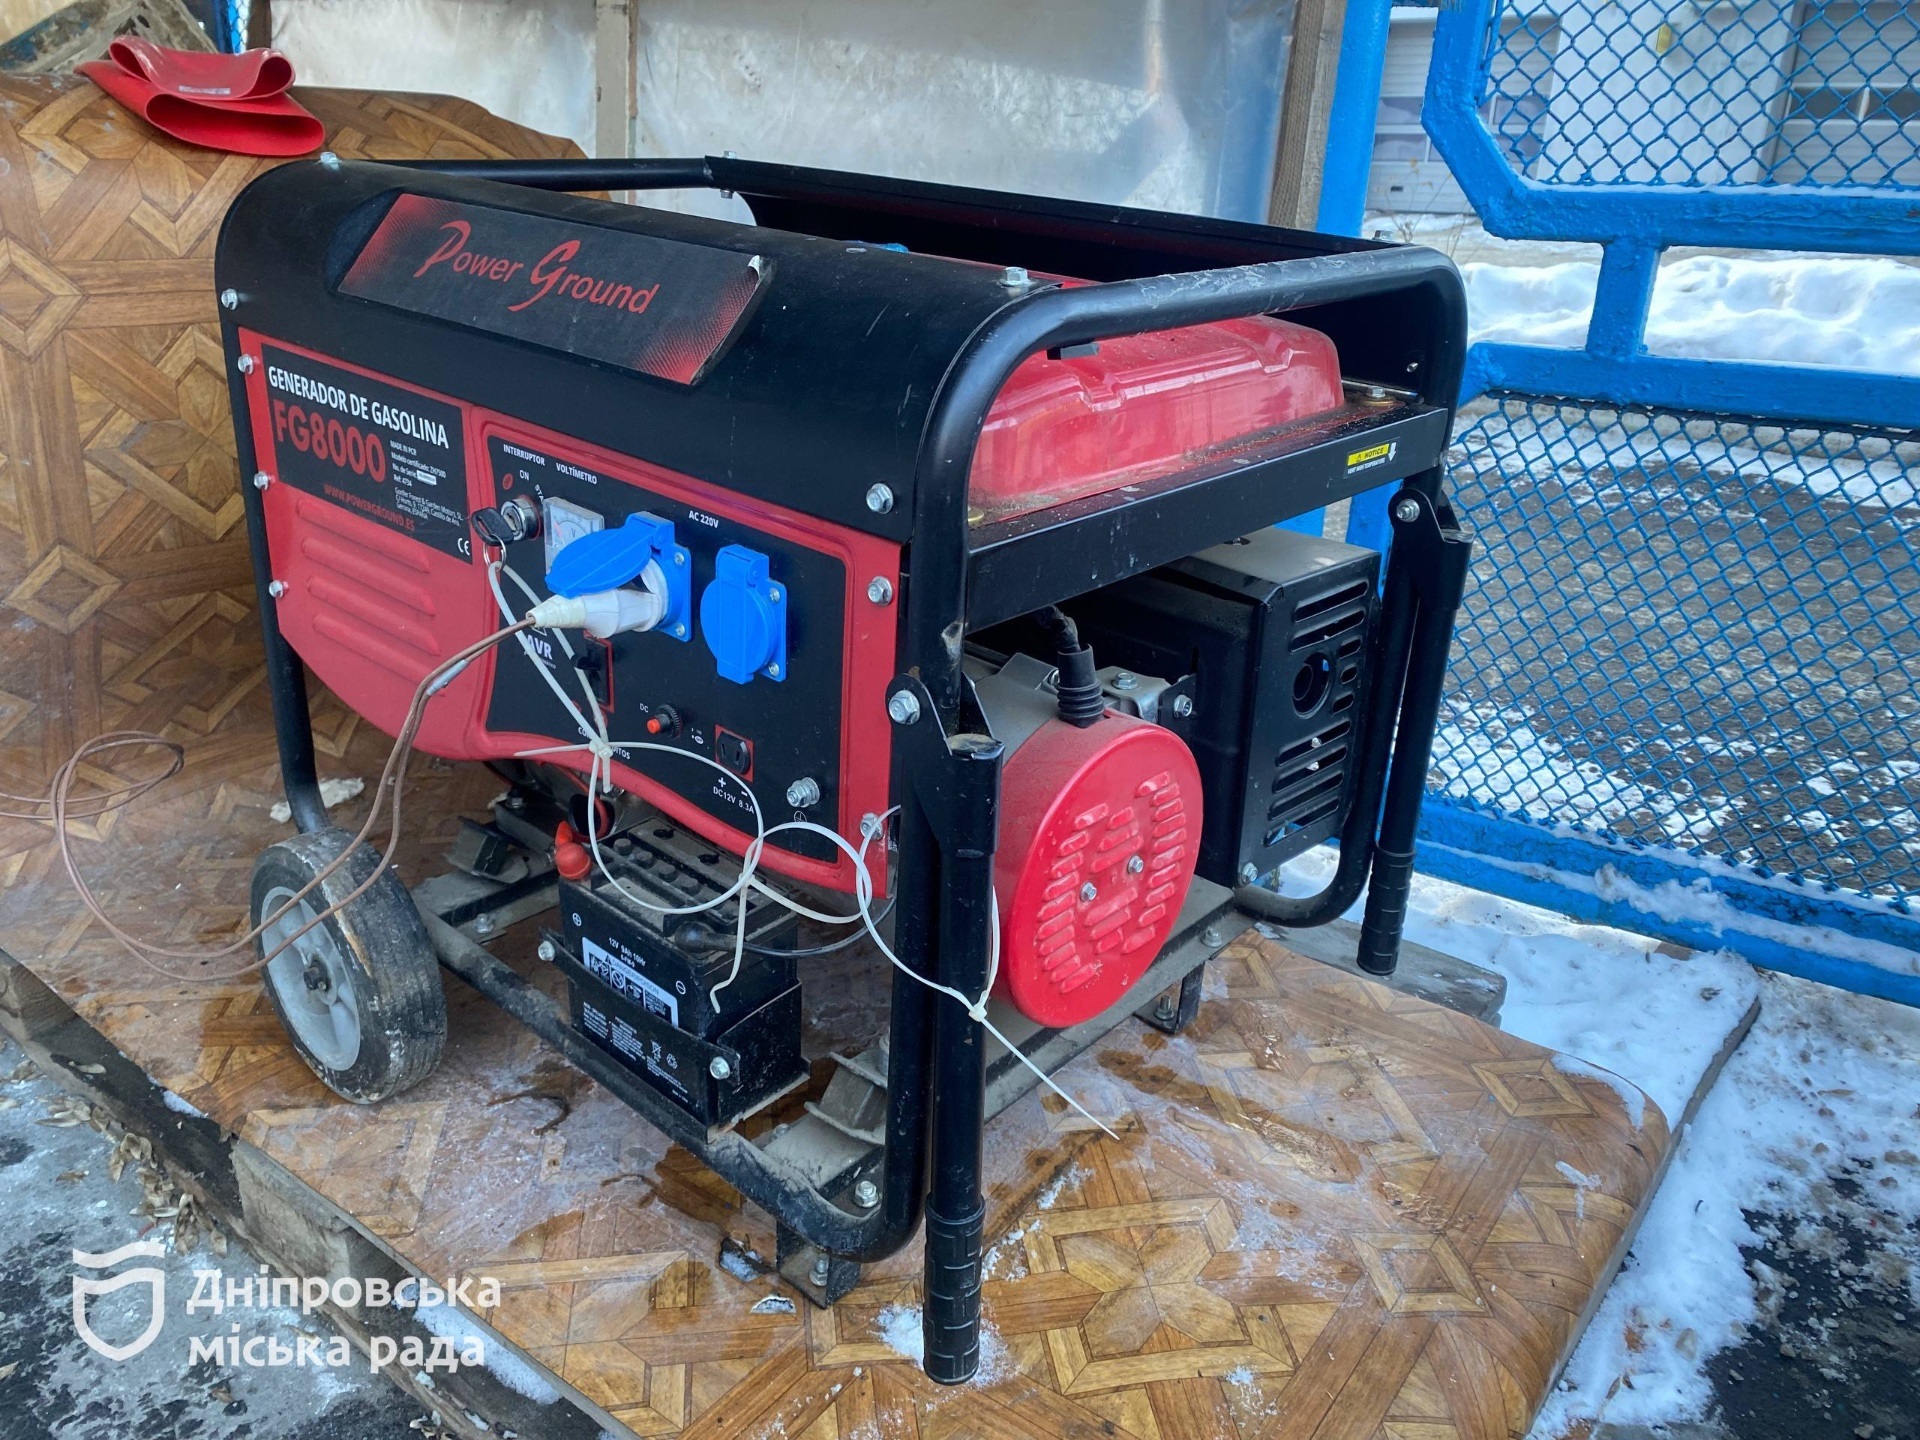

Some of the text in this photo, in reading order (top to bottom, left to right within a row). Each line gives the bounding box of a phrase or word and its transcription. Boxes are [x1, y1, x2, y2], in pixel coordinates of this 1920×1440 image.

[413, 220, 660, 314] Power Ground
[268, 366, 449, 449] GENERADOR DE GASOLINA
[273, 399, 386, 483] FG8000
[390, 440, 402, 450] MADE
[1364, 447, 1384, 458] NOTICE
[503, 444, 598, 485] INTERRUPTOR VOLTÍMETRO
[519, 469, 530, 481] ON
[689, 510, 719, 528] AC 220V
[525, 634, 553, 660] AVR
[639, 703, 649, 713] DC
[713, 786, 755, 814] DC12V 8.3A
[608, 937, 619, 949] 12V
